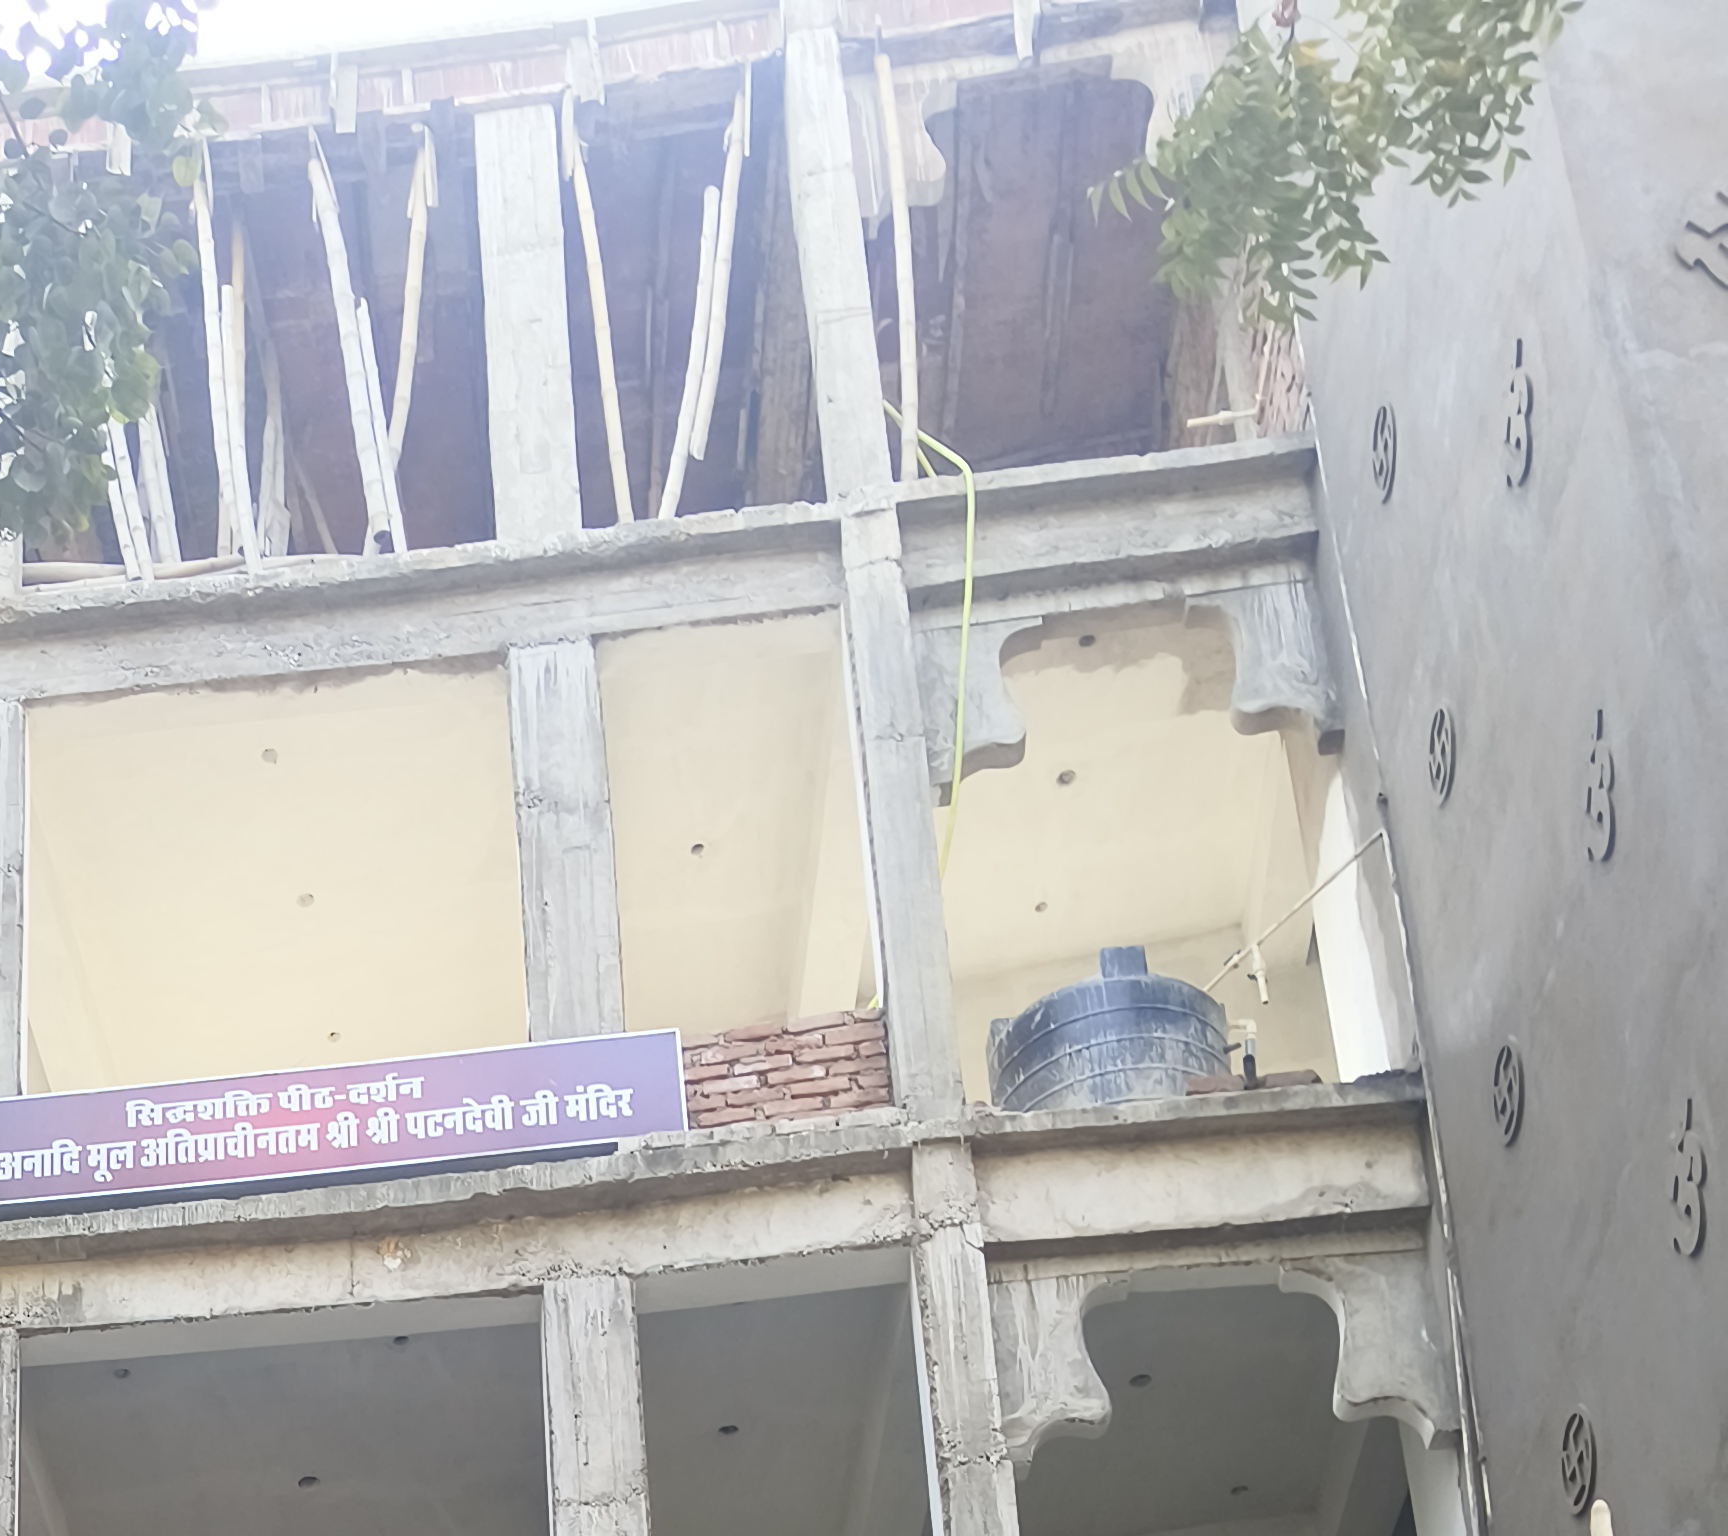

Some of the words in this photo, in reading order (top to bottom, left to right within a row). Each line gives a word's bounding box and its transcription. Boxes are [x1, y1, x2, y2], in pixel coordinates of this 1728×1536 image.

[86, 1141, 136, 1183] मूल
[140, 1122, 320, 1168] अतिप्राचीनतम
[326, 1111, 360, 1149] श्री
[365, 1107, 400, 1145] श्री
[405, 1095, 514, 1139] पटनदेवी
[520, 1089, 559, 1127] जी
[564, 1083, 633, 1122] मंदिर
[126, 1090, 273, 1128] सिद्धशक्ति
